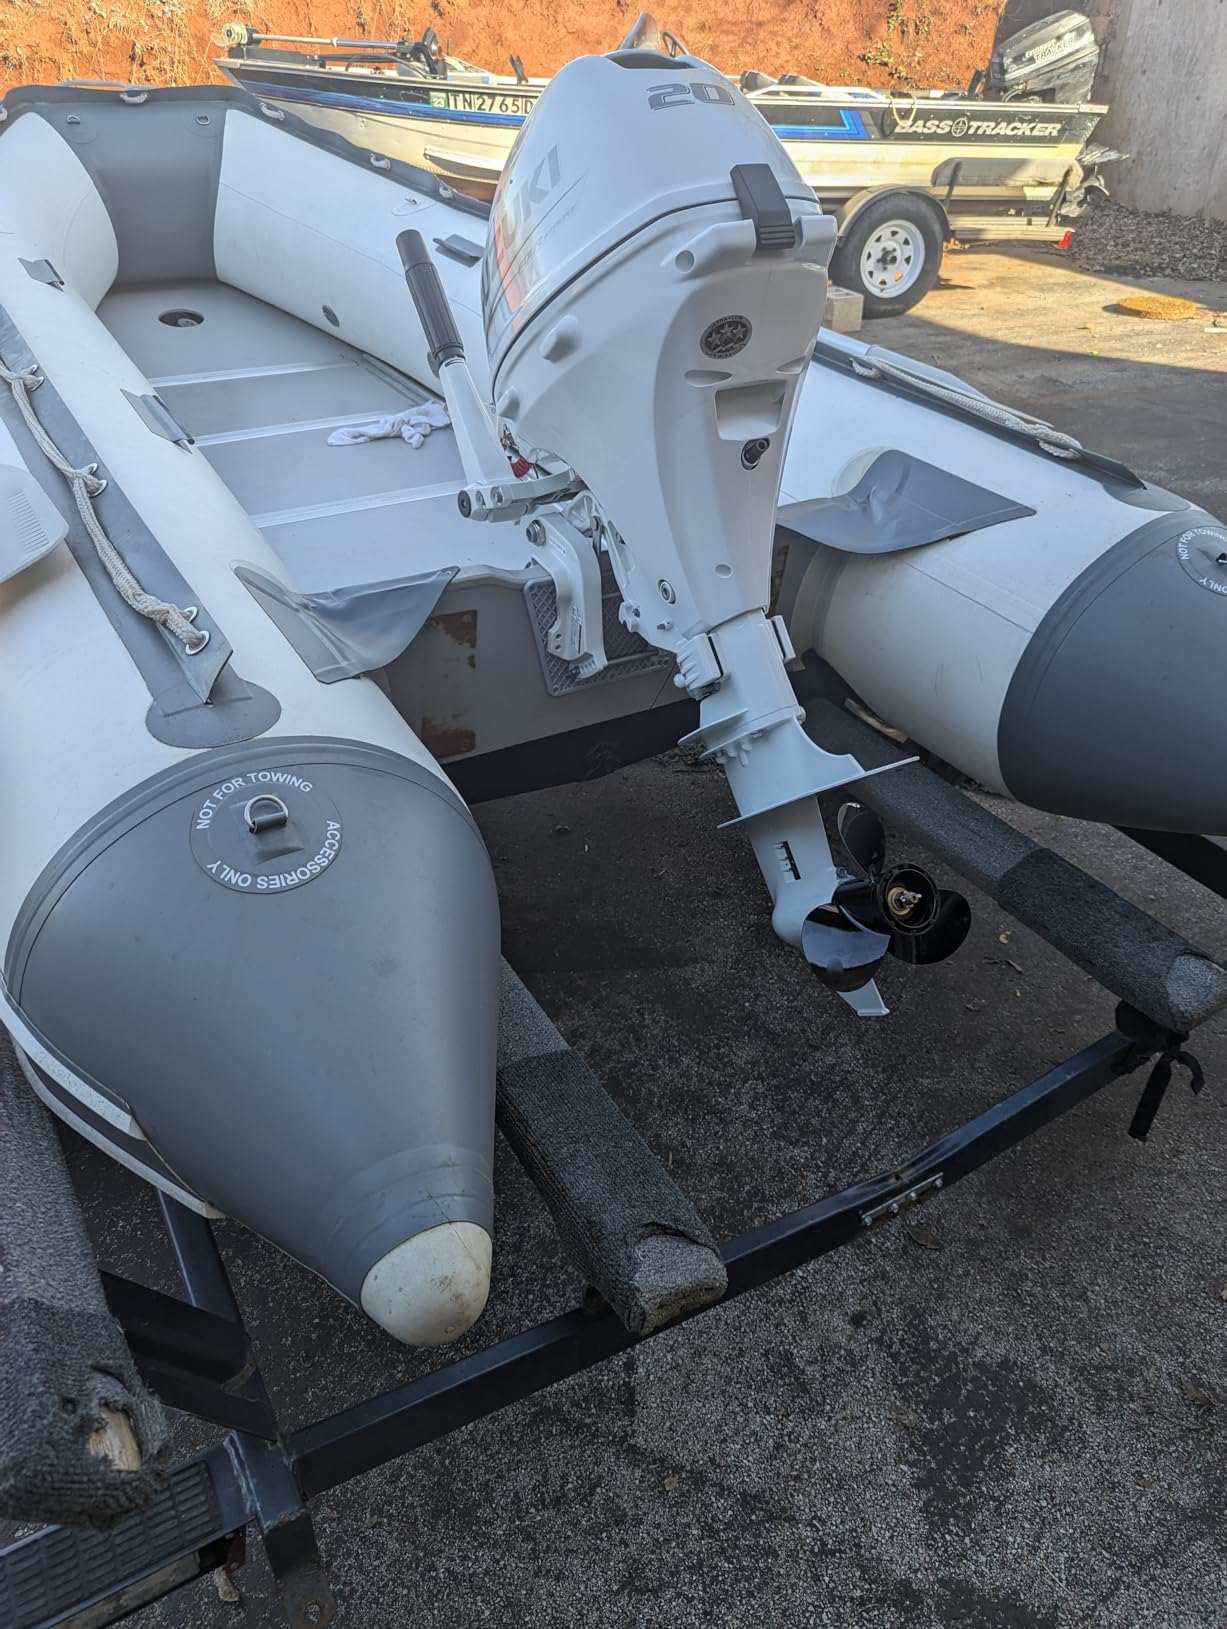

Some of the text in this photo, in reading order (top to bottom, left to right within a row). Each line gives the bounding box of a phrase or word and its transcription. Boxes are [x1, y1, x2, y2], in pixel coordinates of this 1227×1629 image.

[1036, 38, 1075, 60] TRACKER
[450, 93, 472, 110] TN
[476, 96, 520, 114] 2765
[646, 82, 735, 111] 20
[894, 119, 1062, 137] BASS TRACKER
[1180, 530, 1196, 543] FOR
[1179, 543, 1190, 560] NOT
[196, 771, 313, 830] NOT FOR TOWING
[206, 820, 341, 889] ACCESSORIES ONLY
